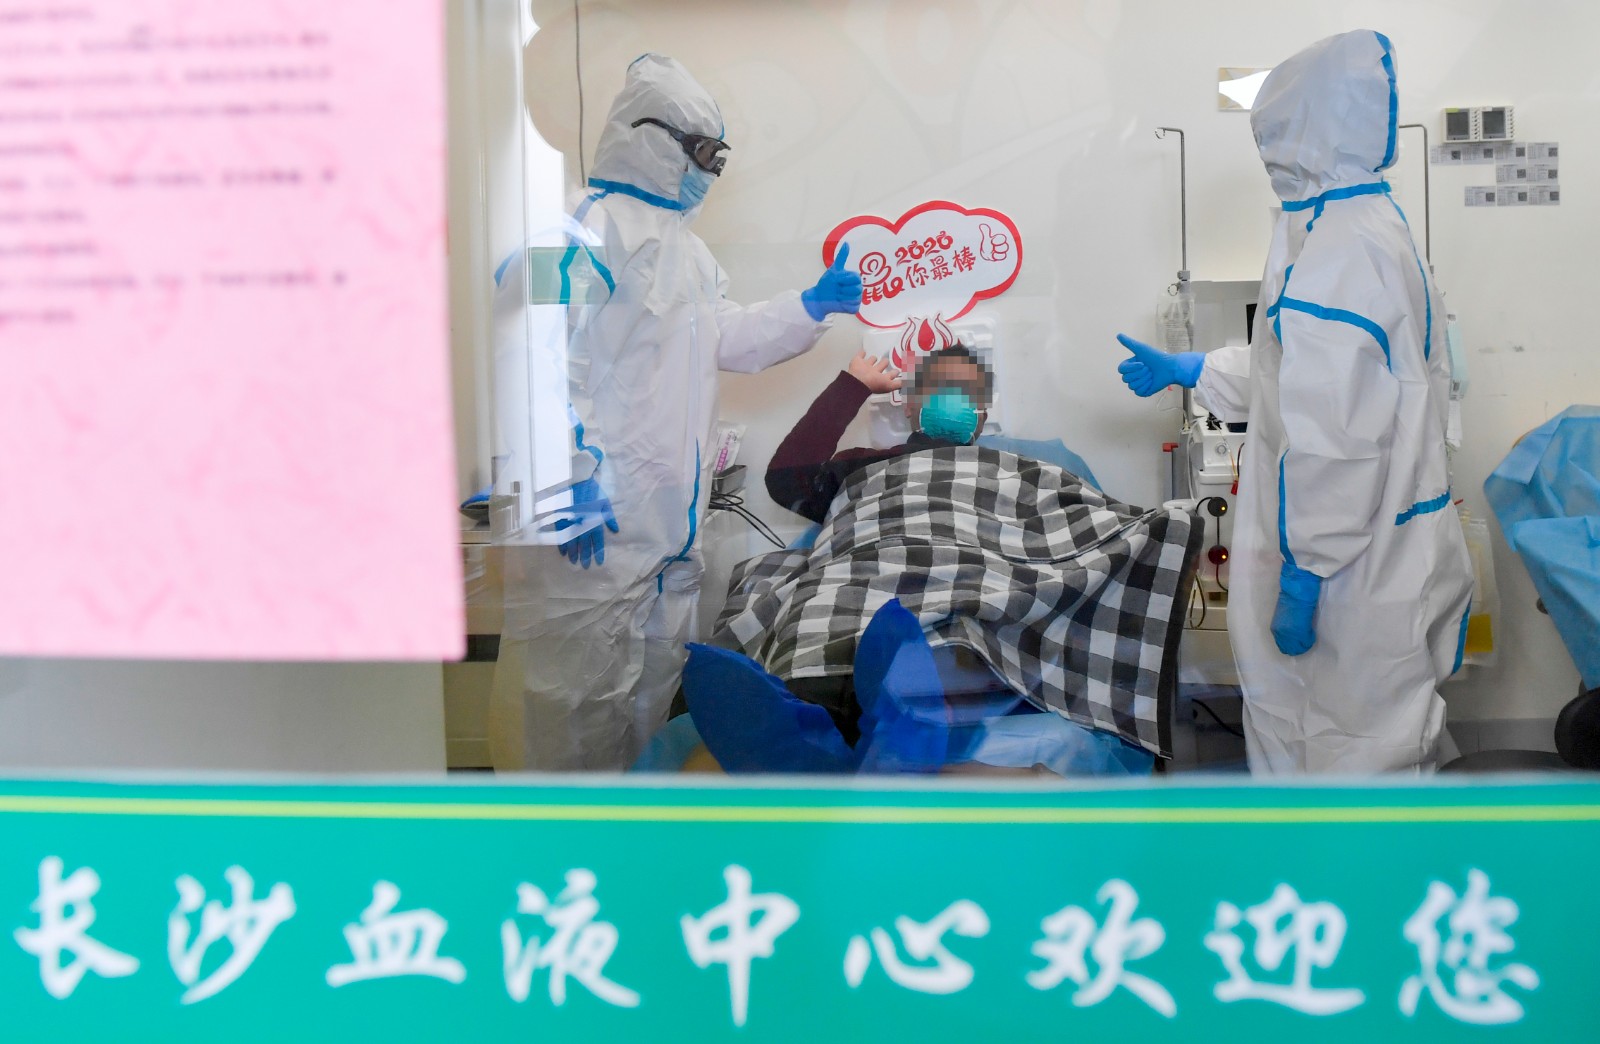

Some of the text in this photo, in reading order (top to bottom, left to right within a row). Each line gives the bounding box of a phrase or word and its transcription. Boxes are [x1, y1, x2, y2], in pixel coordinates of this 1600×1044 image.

[895, 231, 954, 266] 2020
[906, 246, 976, 288] 你最棒
[13, 855, 1539, 1027] 长沙血液中心欢迎您
